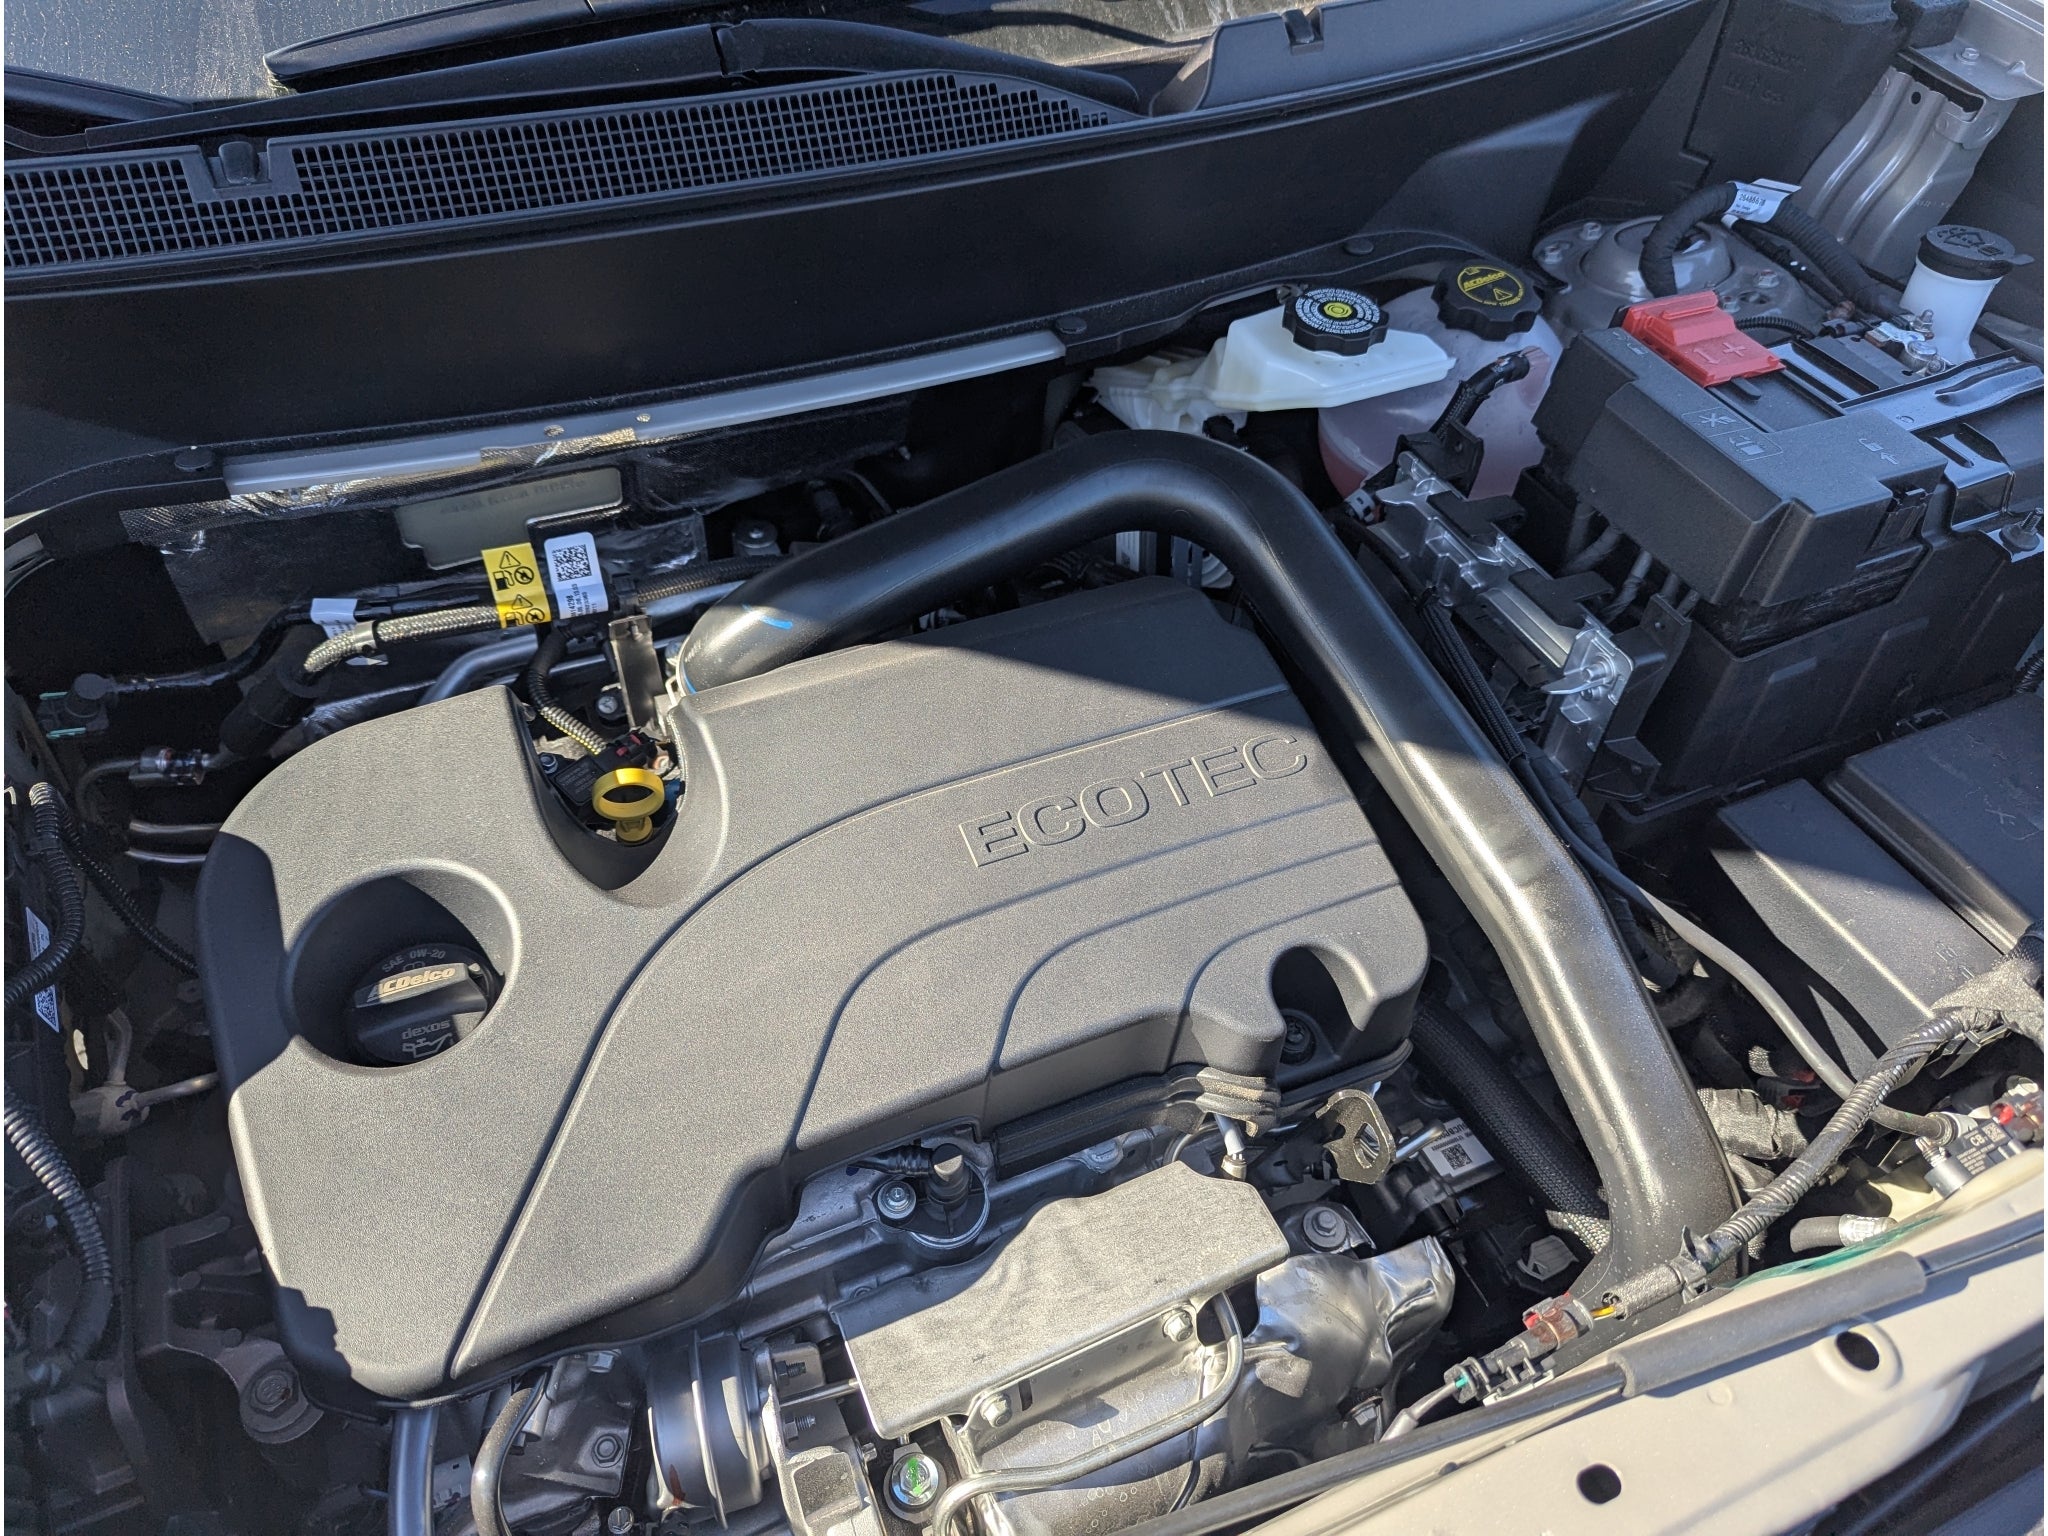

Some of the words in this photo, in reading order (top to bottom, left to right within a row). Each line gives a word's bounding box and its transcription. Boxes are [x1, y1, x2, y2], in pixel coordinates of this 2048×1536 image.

[1463, 271, 1506, 290] ACDelco
[958, 733, 1308, 868] ECOTEC
[382, 955, 405, 973] SAE
[409, 949, 446, 960] 0W-20
[366, 967, 456, 1001] ACDelco
[401, 1020, 450, 1040] dexos
